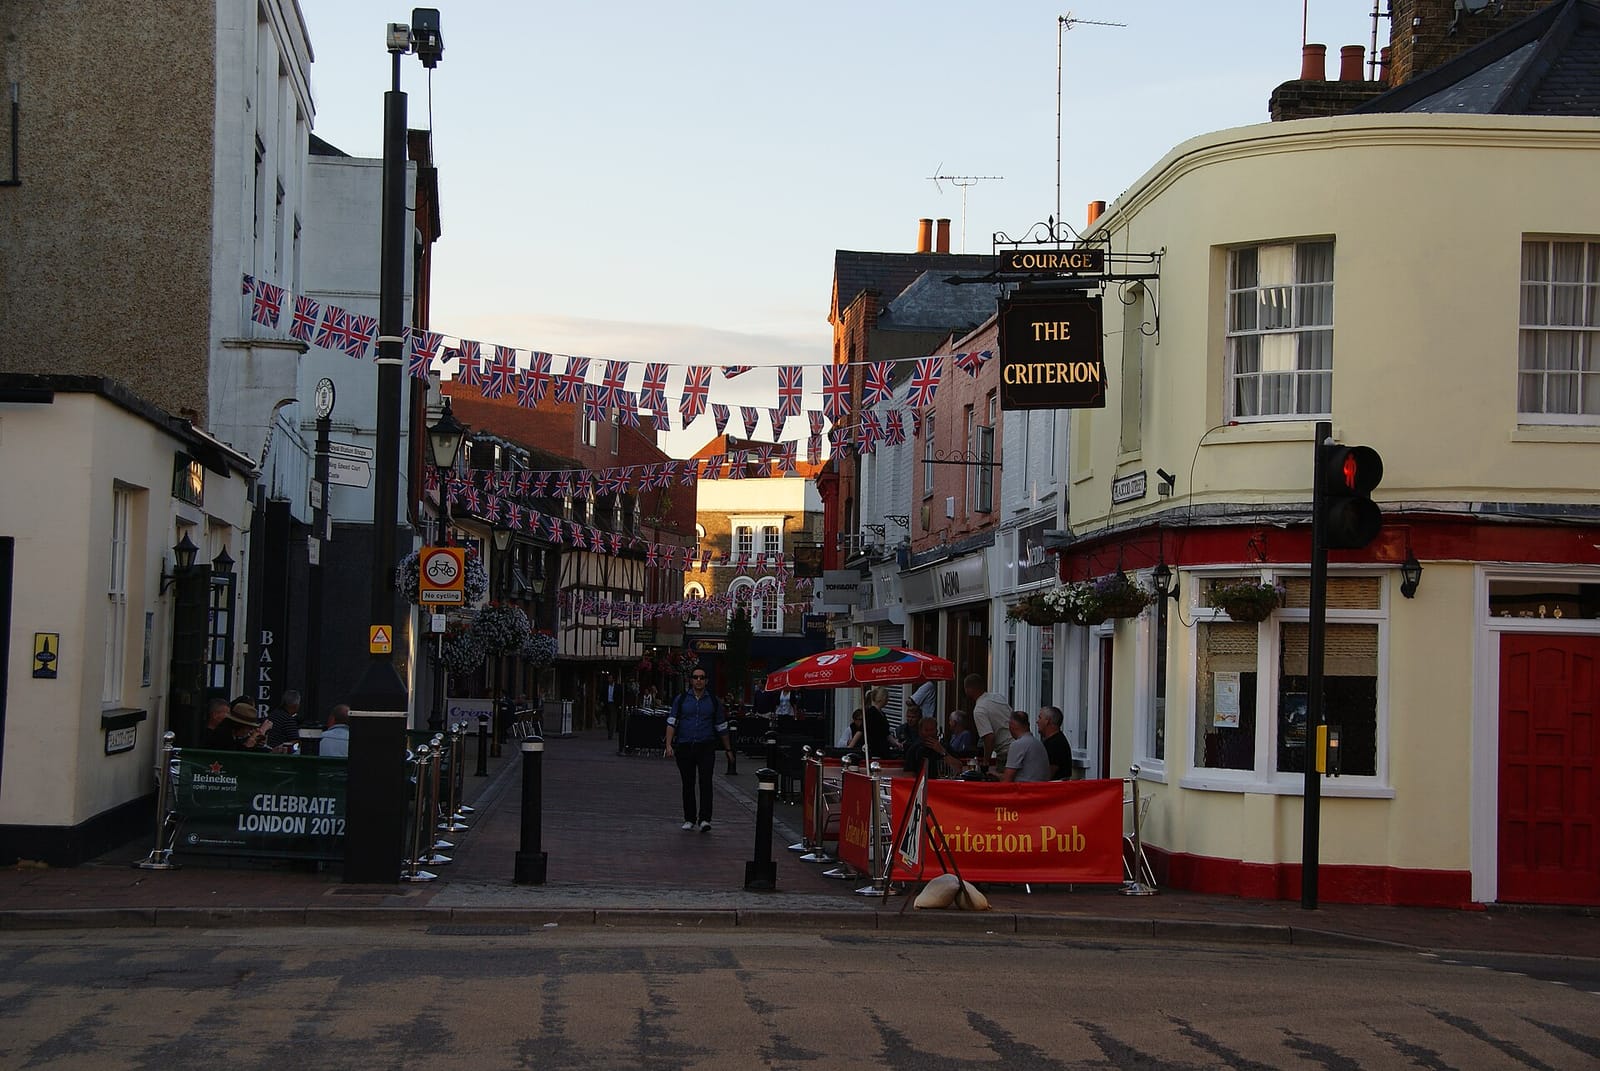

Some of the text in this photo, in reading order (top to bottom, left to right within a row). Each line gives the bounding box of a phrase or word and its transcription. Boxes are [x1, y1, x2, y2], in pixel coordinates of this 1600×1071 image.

[1011, 253, 1093, 269] COURAGE
[1031, 321, 1071, 341] THE
[1003, 361, 1101, 385] CRITERION
[193, 773, 237, 784] Heineken
[253, 794, 336, 814] CELEBRATE
[238, 813, 345, 835] LONDON 2012
[994, 807, 1020, 822] The
[1040, 825, 1086, 853] Pub
